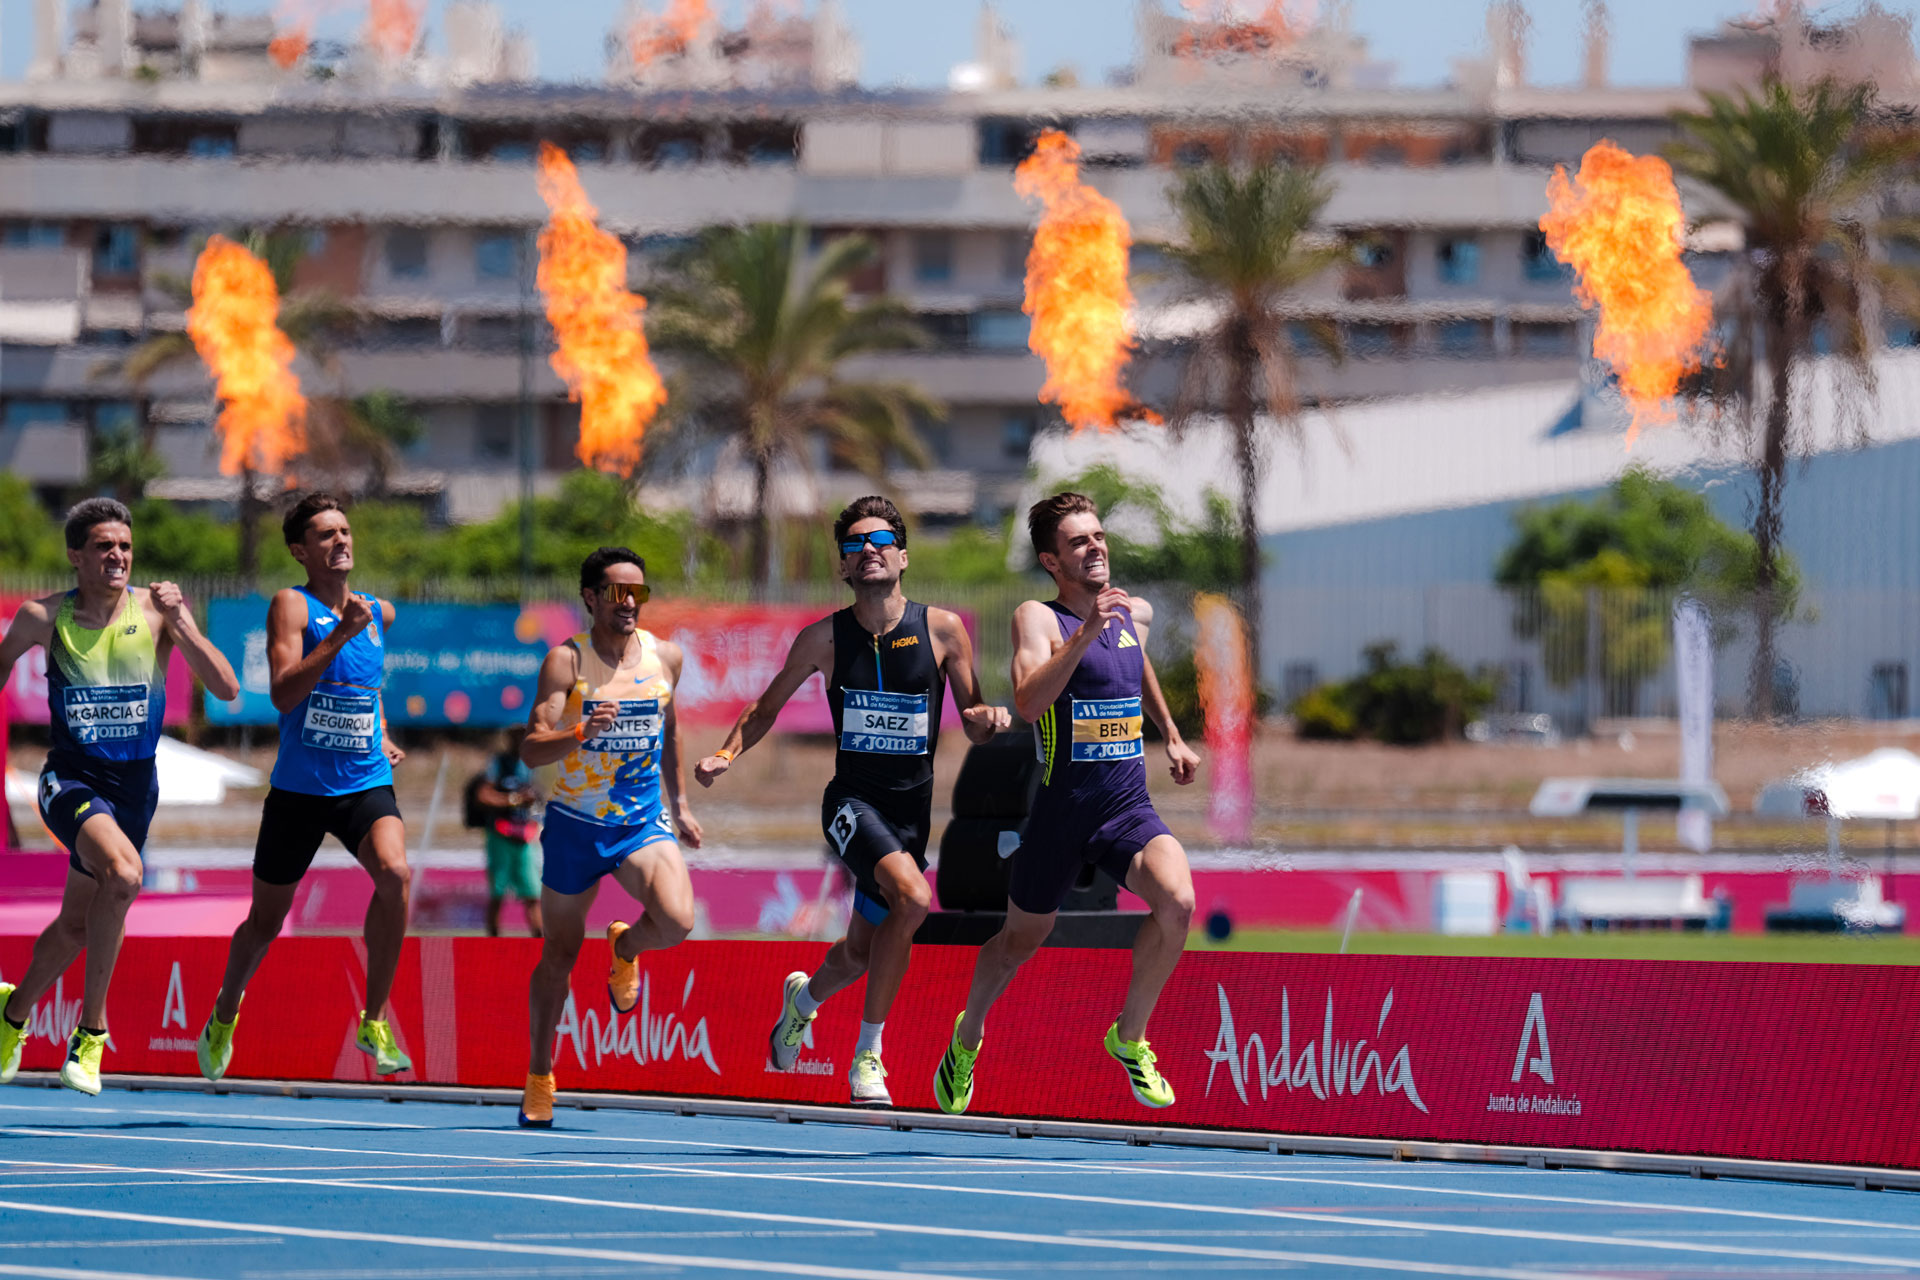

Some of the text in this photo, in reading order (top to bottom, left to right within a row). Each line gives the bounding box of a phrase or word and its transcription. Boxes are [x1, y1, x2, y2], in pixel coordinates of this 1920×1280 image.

[891, 635, 919, 648] HOKA
[67, 706, 133, 722] M.GARCIA
[310, 712, 371, 731] SEGUROLA
[864, 714, 909, 731] SAEZ
[1099, 722, 1129, 738] BEN
[835, 814, 852, 845] 8
[1203, 982, 1430, 1115] Andalucía
[797, 1057, 834, 1076] Andalucía
[1486, 1092, 1582, 1116] Junta de Andalucía
